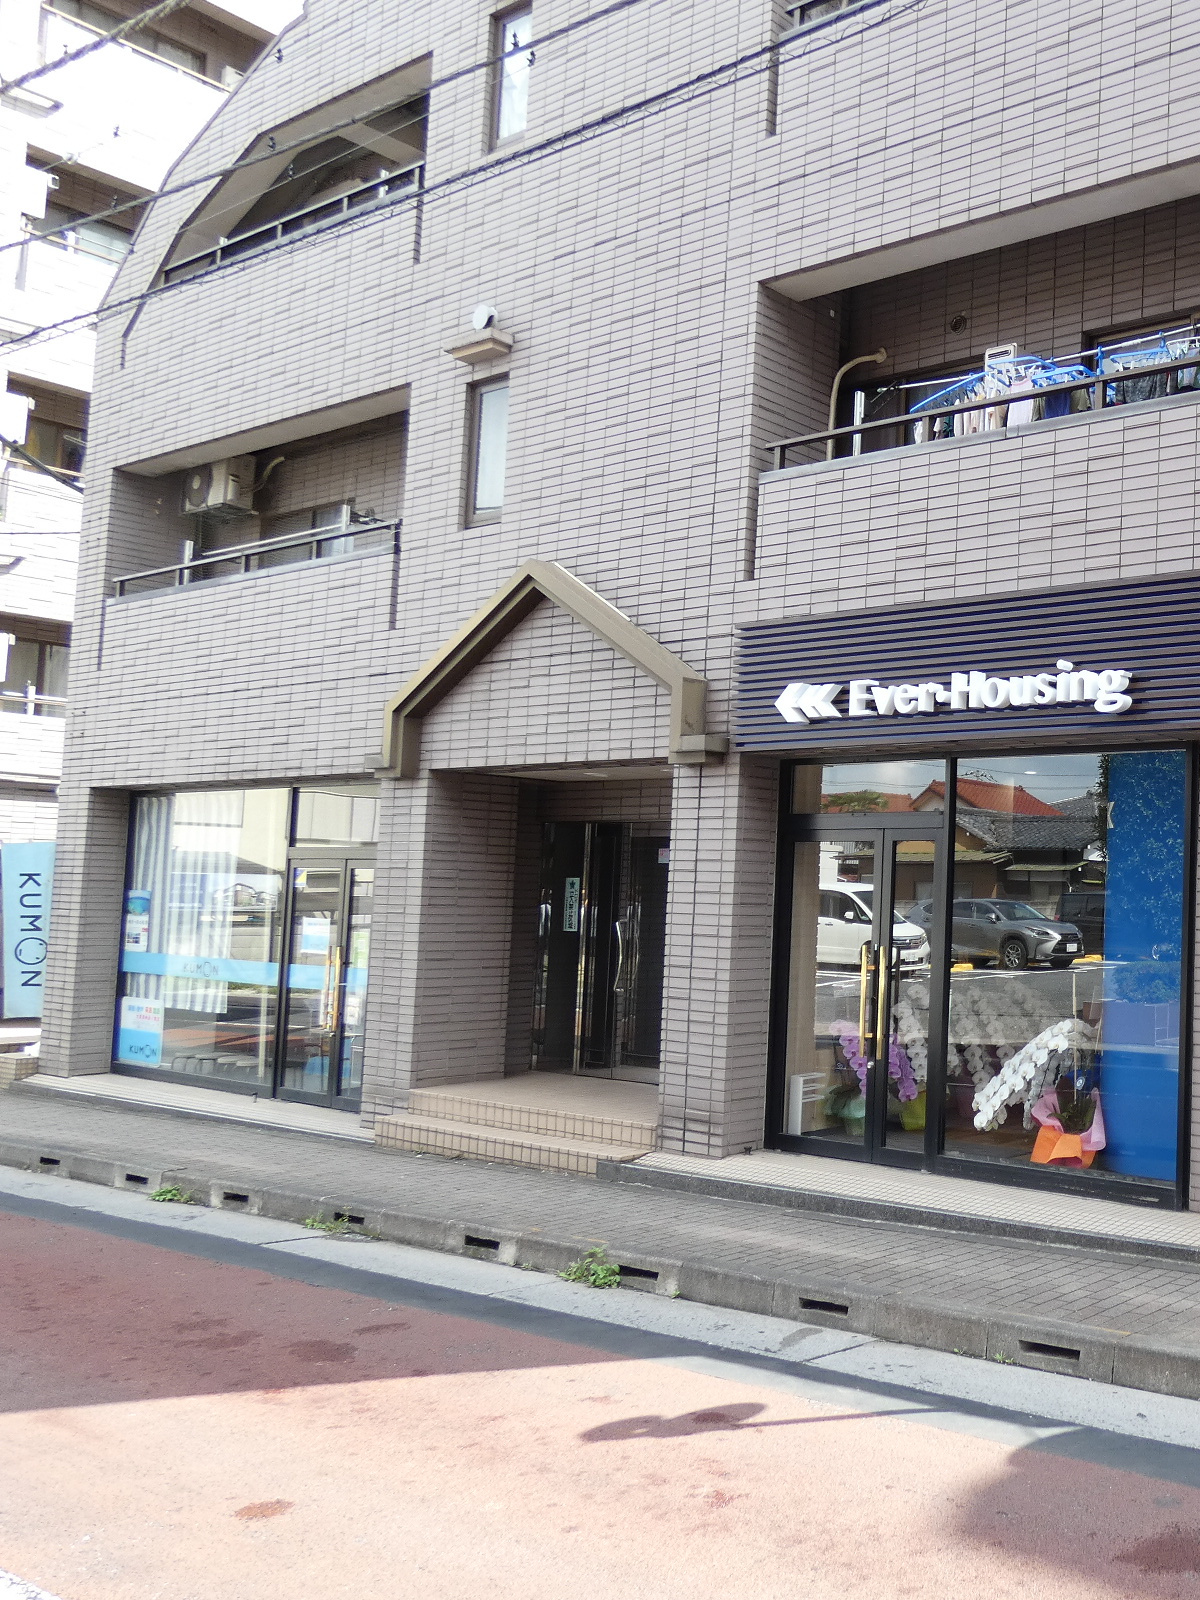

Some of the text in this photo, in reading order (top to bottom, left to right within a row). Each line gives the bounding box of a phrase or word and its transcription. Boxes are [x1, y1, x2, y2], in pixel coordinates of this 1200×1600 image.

[849, 659, 1133, 715] Ever-Housing
[14, 873, 48, 987] KUMON
[183, 961, 219, 977] KUMON
[129, 1044, 157, 1058] KUMON
